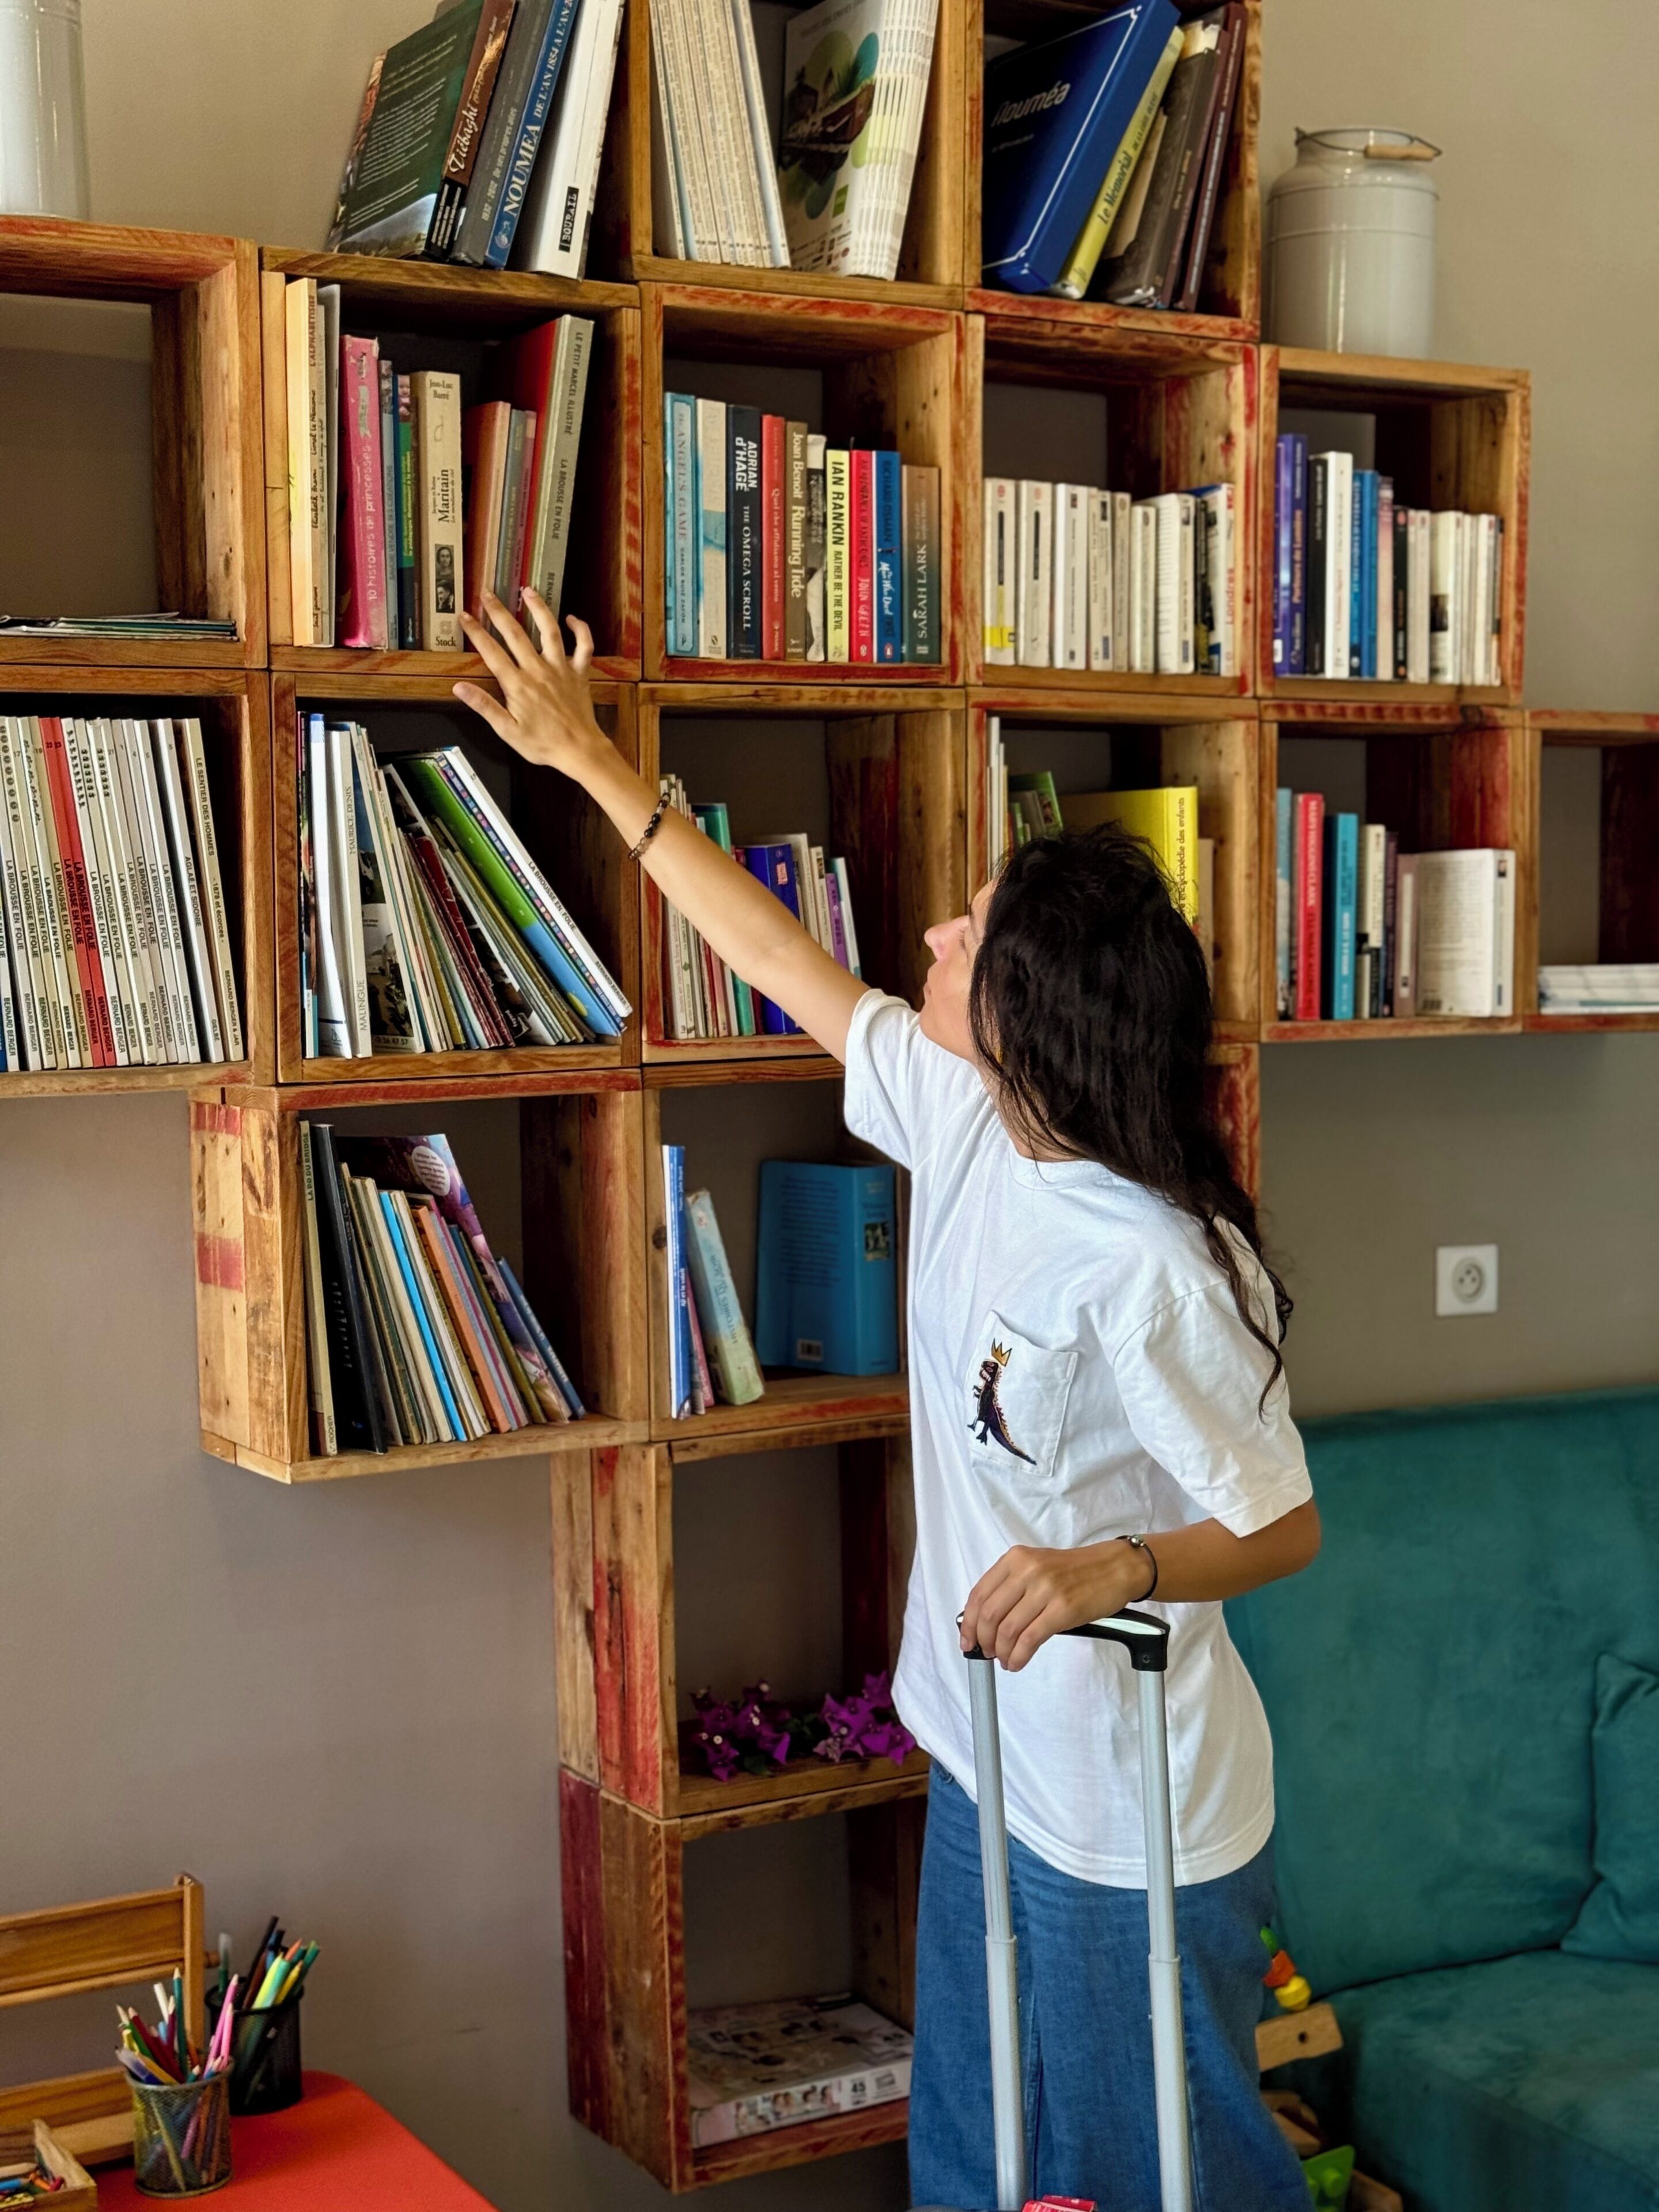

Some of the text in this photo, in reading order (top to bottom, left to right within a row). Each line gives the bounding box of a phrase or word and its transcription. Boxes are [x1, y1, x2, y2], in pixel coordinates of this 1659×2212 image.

[503, 124, 541, 217] NOUMEA
[562, 192, 577, 241] BOURAIL
[429, 379, 453, 389] Jean-Luc
[433, 389, 450, 400] Barré
[563, 331, 584, 435] LE PETIT MARCEL ILLUSTRÉ
[676, 430, 687, 540] ANGEL'S GAME
[745, 441, 759, 488] ADRIAN
[791, 431, 804, 499] Joan Benoit
[436, 468, 450, 523] Maritain
[551, 458, 569, 540] LA BROUSSE EN FOLIE
[771, 487, 781, 510] Quel
[772, 510, 780, 525] che
[831, 461, 844, 546] IAN RANKIN
[360, 444, 378, 600] 10 histoires de princesses
[742, 526, 751, 575] OMEGA
[771, 527, 781, 569] affidiamo
[787, 505, 805, 598] Running Tide
[916, 544, 927, 584] LARK
[544, 571, 555, 607] BERNARD
[772, 570, 781, 578] al
[833, 550, 842, 631] RATHER BE THE DEVIL
[1224, 567, 1236, 625] Londres
[742, 579, 751, 631] SCROLL
[857, 577, 870, 637] JOHN GREEN
[916, 587, 927, 638] SARAH
[435, 635, 457, 647] Stock
[195, 757, 215, 857] LE SENTIER DES HOMMES
[345, 785, 356, 855] MAURICE DENIS
[1175, 797, 1185, 827] enfants
[1176, 829, 1185, 843] des
[73, 861, 97, 950] LA BROUSSE EN FOLIE
[189, 883, 196, 895] ET
[191, 895, 202, 927] SIDONIE
[215, 901, 221, 909] et
[528, 861, 576, 931] LA BROUSSE EN FOLIE
[20, 870, 39, 959] LA BROUSSE EN FOLIE
[215, 910, 225, 938] écorces
[224, 969, 233, 1001] BERNARD
[229, 1001, 237, 1027] BERGER
[355, 980, 367, 1031] MALINGUE
[594, 961, 627, 1005] BERNARD BERGER
[110, 995, 126, 1054] BERNARD BERGER
[302, 1132, 311, 1164] BRIDGE
[305, 1164, 312, 1177] DU
[307, 1190, 315, 1202] LA
[710, 1253, 720, 1277] SOIR
[722, 1298, 738, 1344] HISTOIRES
[850, 2081, 867, 2093] 45
